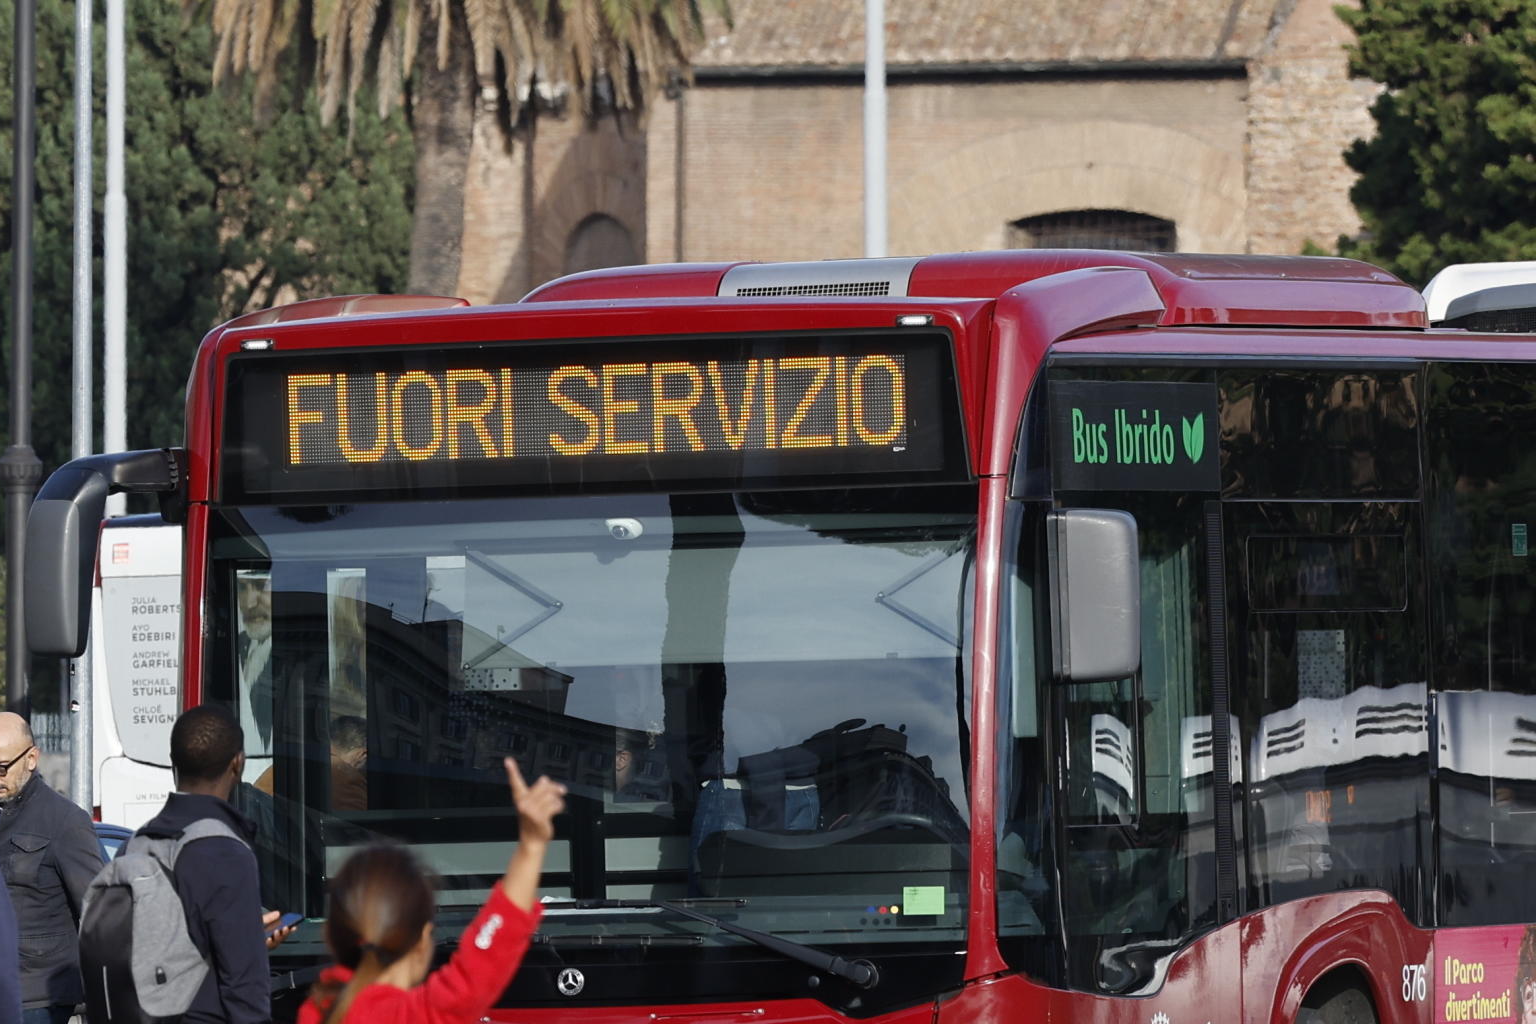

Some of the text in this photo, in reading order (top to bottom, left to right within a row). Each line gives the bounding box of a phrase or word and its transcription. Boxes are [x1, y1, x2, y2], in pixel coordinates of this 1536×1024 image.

[286, 354, 907, 465] FUORI SERVIZIO
[1072, 408, 1174, 465] Bus Ibrido
[132, 597, 156, 605] JULIA
[132, 632, 175, 642] EDEBIRI
[133, 651, 169, 659] ANDREW
[132, 659, 178, 669] GARFIEL
[132, 687, 177, 697] STUHLB
[133, 714, 176, 725] SEVIGN
[1445, 956, 1484, 985] Il Parco
[1402, 964, 1426, 1002] 876
[1445, 988, 1511, 1023] divertimenti
